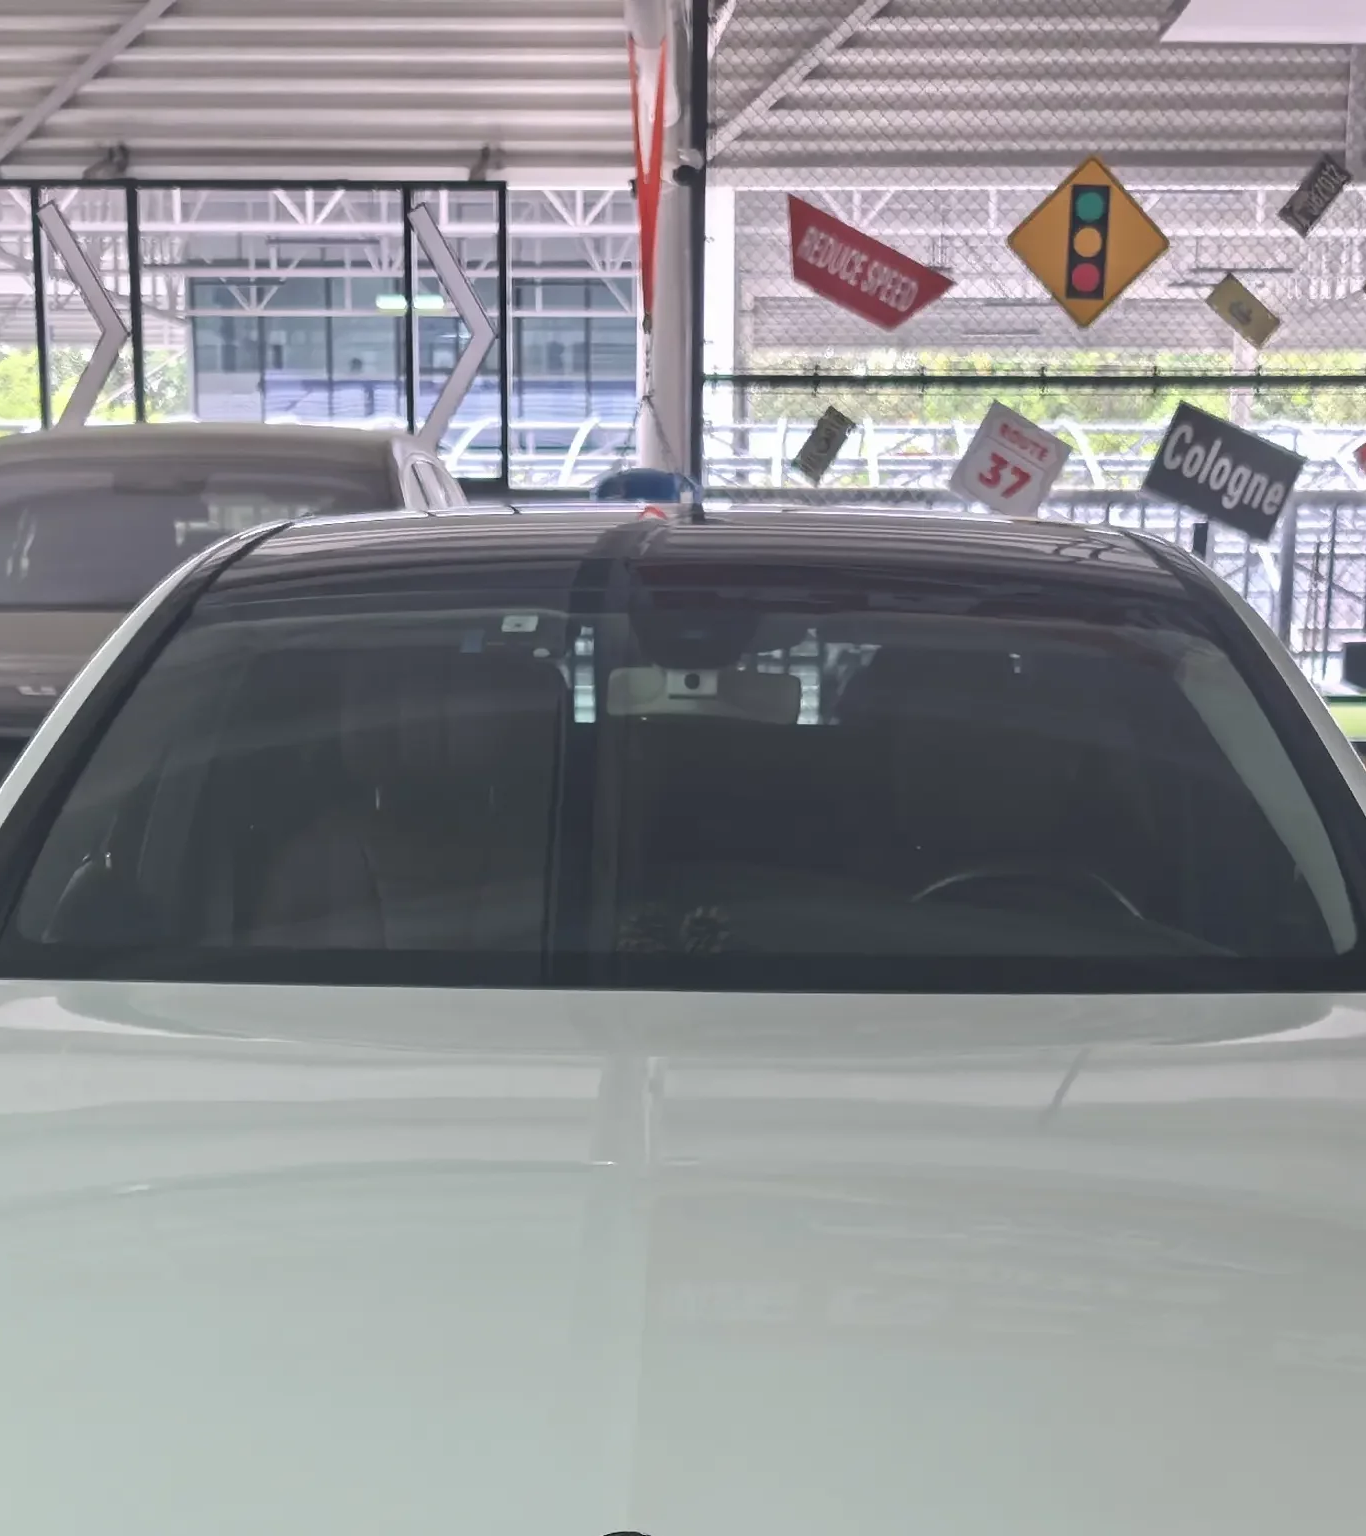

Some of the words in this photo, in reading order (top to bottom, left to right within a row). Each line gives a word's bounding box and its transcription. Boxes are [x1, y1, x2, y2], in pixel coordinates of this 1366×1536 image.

[796, 225, 869, 287] REDUCE
[860, 260, 919, 312] SPEED
[999, 422, 1049, 461] ROUTE
[1163, 424, 1285, 515] Cologne
[978, 452, 1031, 499] 37
